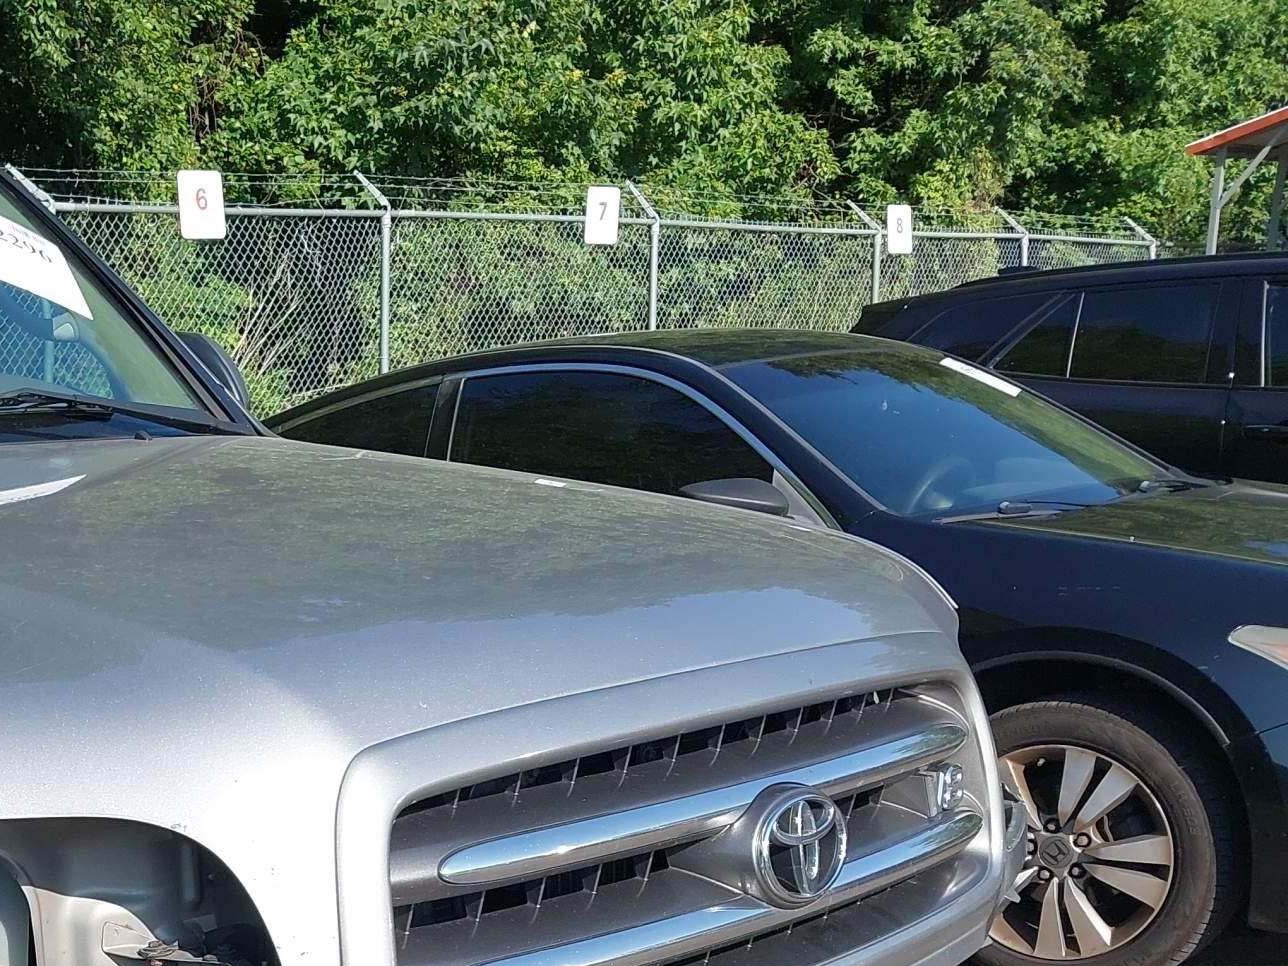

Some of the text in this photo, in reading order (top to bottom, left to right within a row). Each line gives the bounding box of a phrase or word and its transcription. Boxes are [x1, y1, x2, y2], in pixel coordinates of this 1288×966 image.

[195, 187, 209, 211] 6
[599, 201, 608, 221] 7
[896, 217, 904, 234] 8
